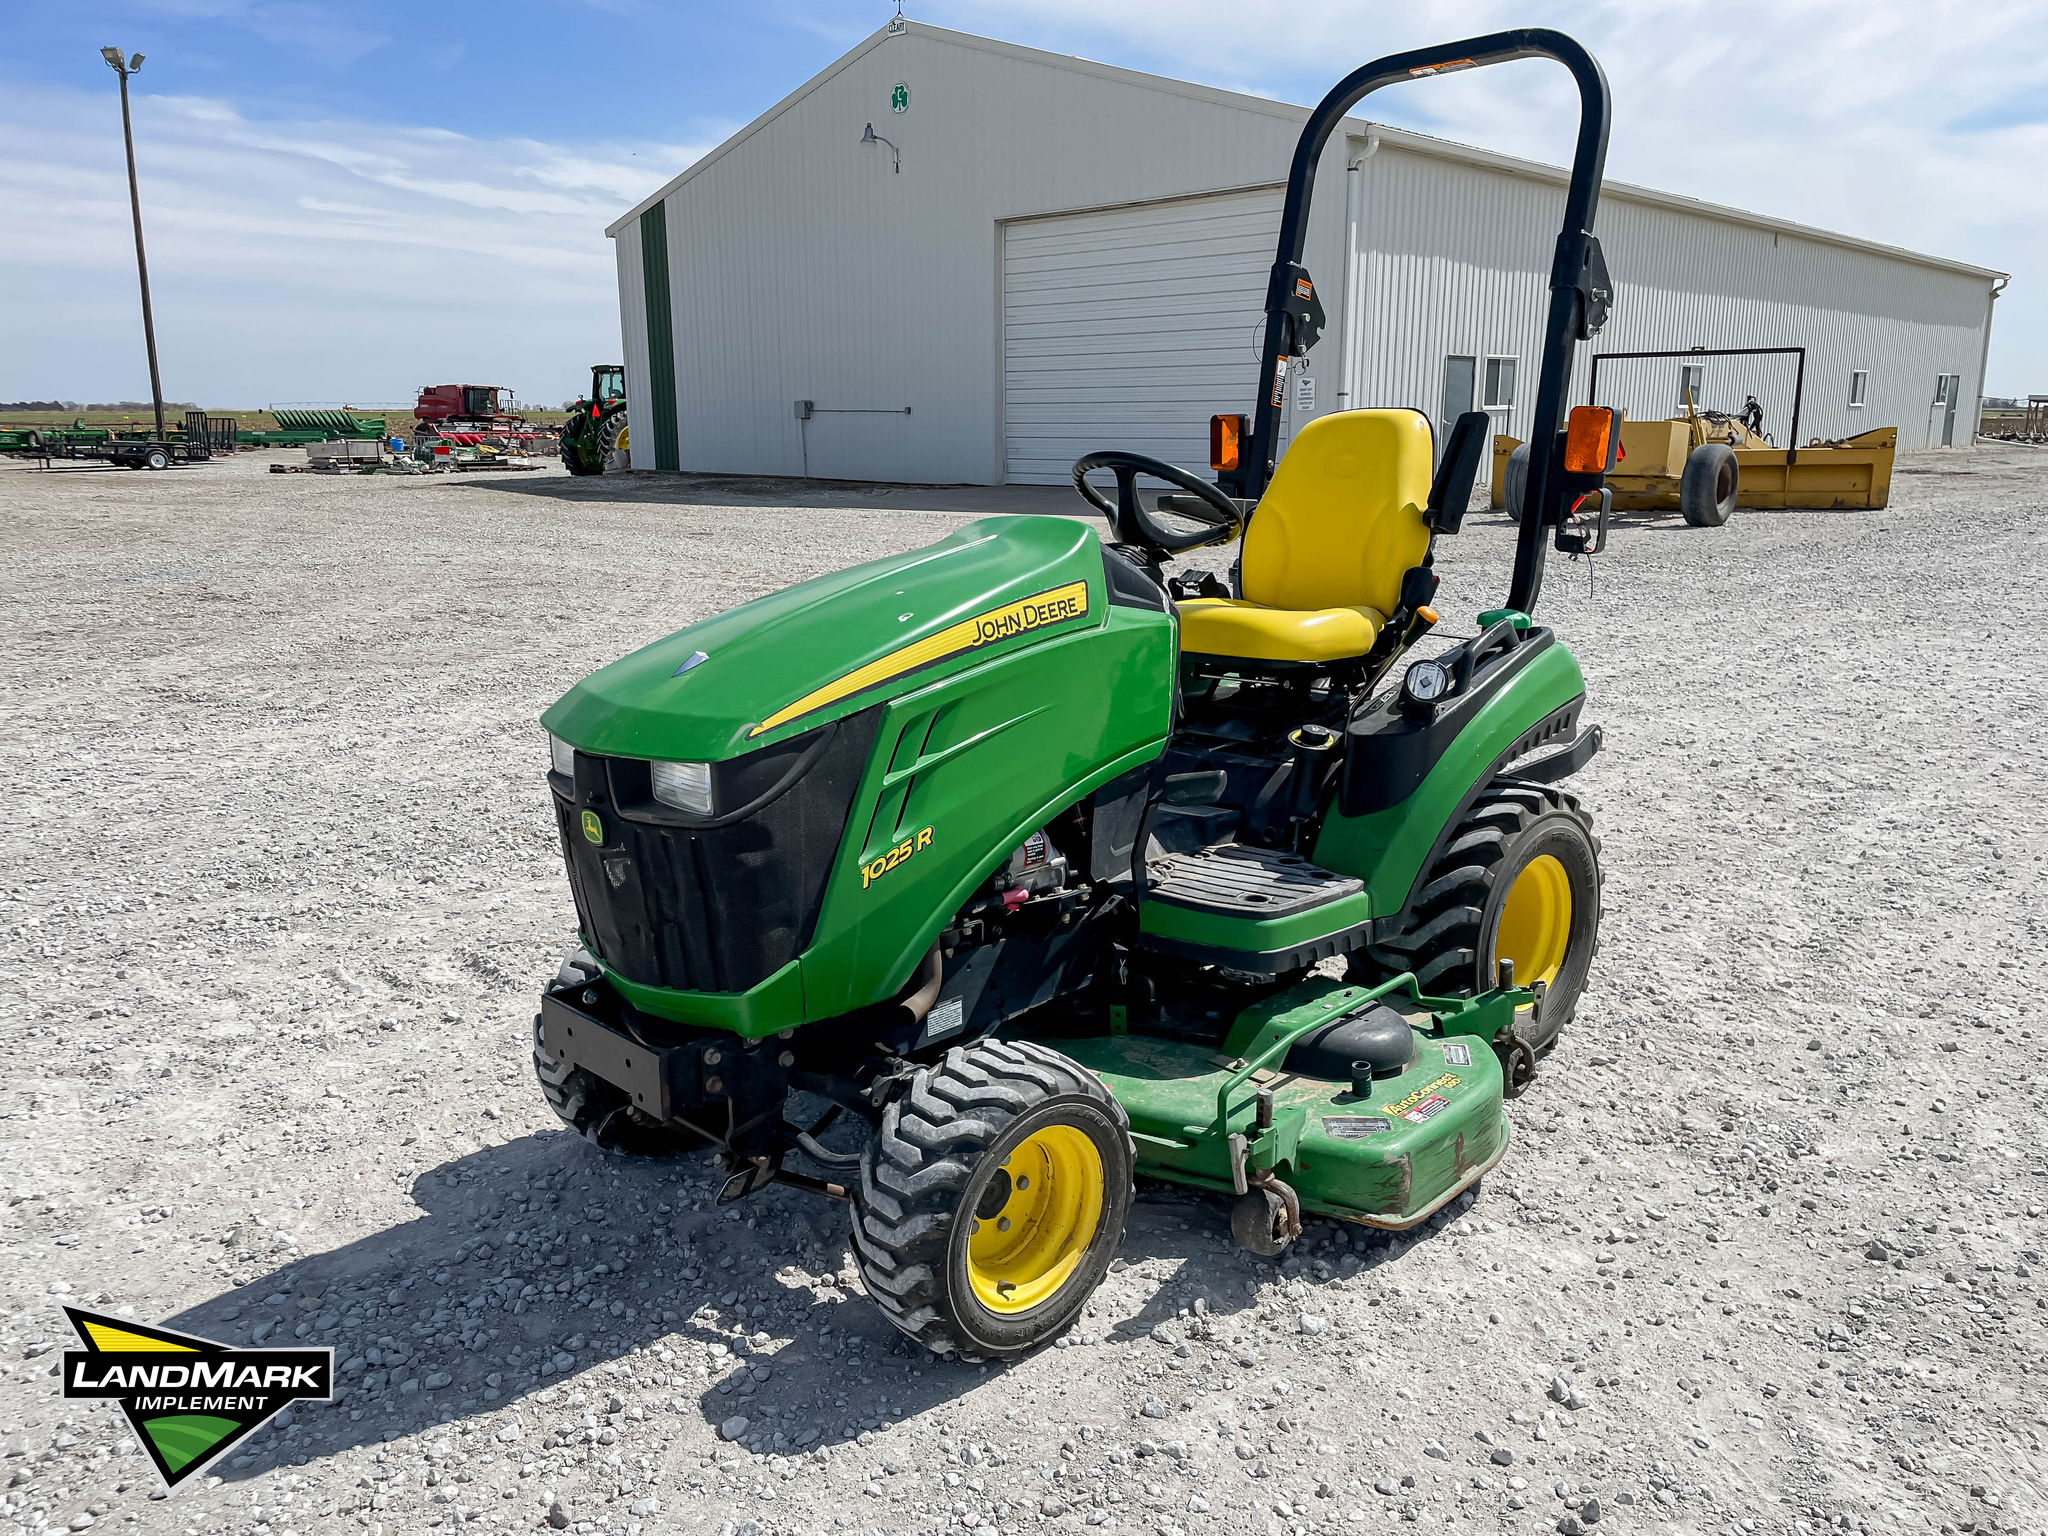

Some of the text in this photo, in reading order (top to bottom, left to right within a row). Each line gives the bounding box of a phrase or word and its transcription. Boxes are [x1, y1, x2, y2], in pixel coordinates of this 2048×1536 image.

[971, 596, 1080, 644] JOHN DEERE
[860, 826, 934, 890] 1025 R
[1387, 1071, 1458, 1116] AutoConnect
